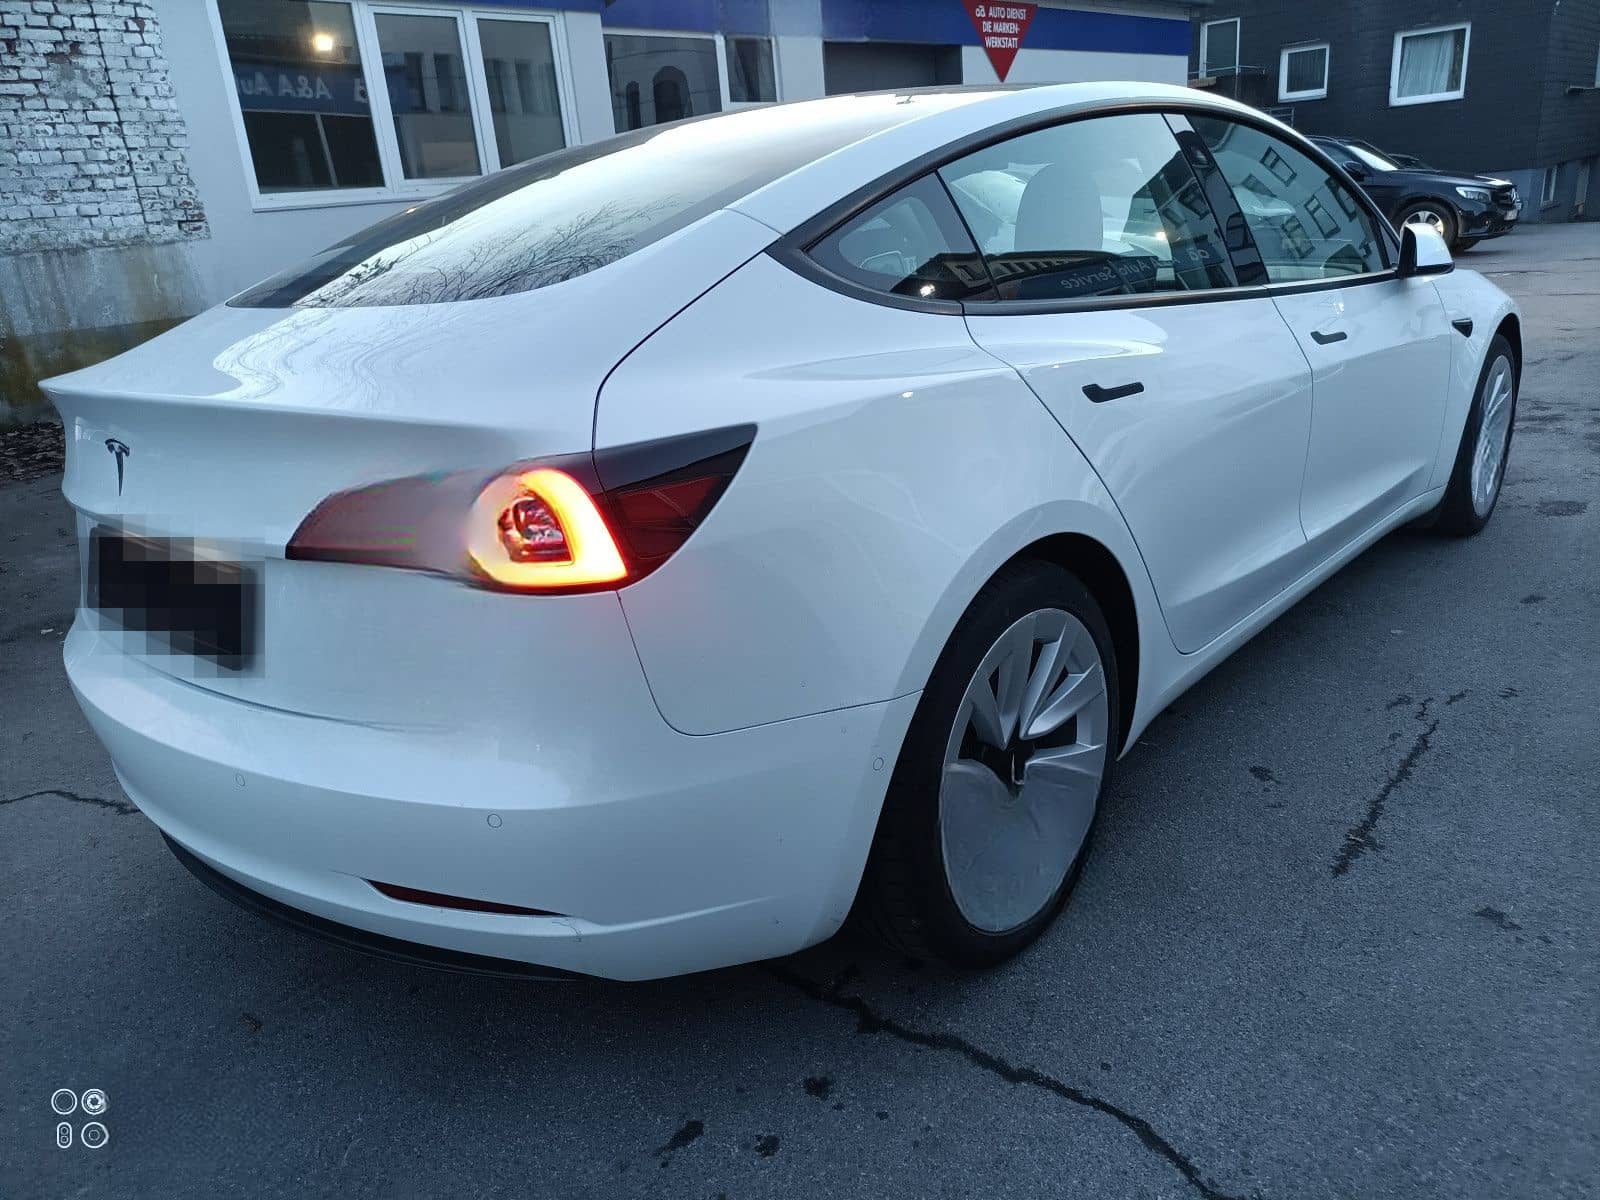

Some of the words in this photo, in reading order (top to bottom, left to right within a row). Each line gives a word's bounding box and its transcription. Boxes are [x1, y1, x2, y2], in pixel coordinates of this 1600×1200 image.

[989, 6, 1005, 18] AUTO
[1006, 8, 1026, 20] DIENST
[983, 21, 992, 33] DIE
[993, 22, 1020, 34] MARKEN-
[985, 36, 1018, 48] WERKSTATT
